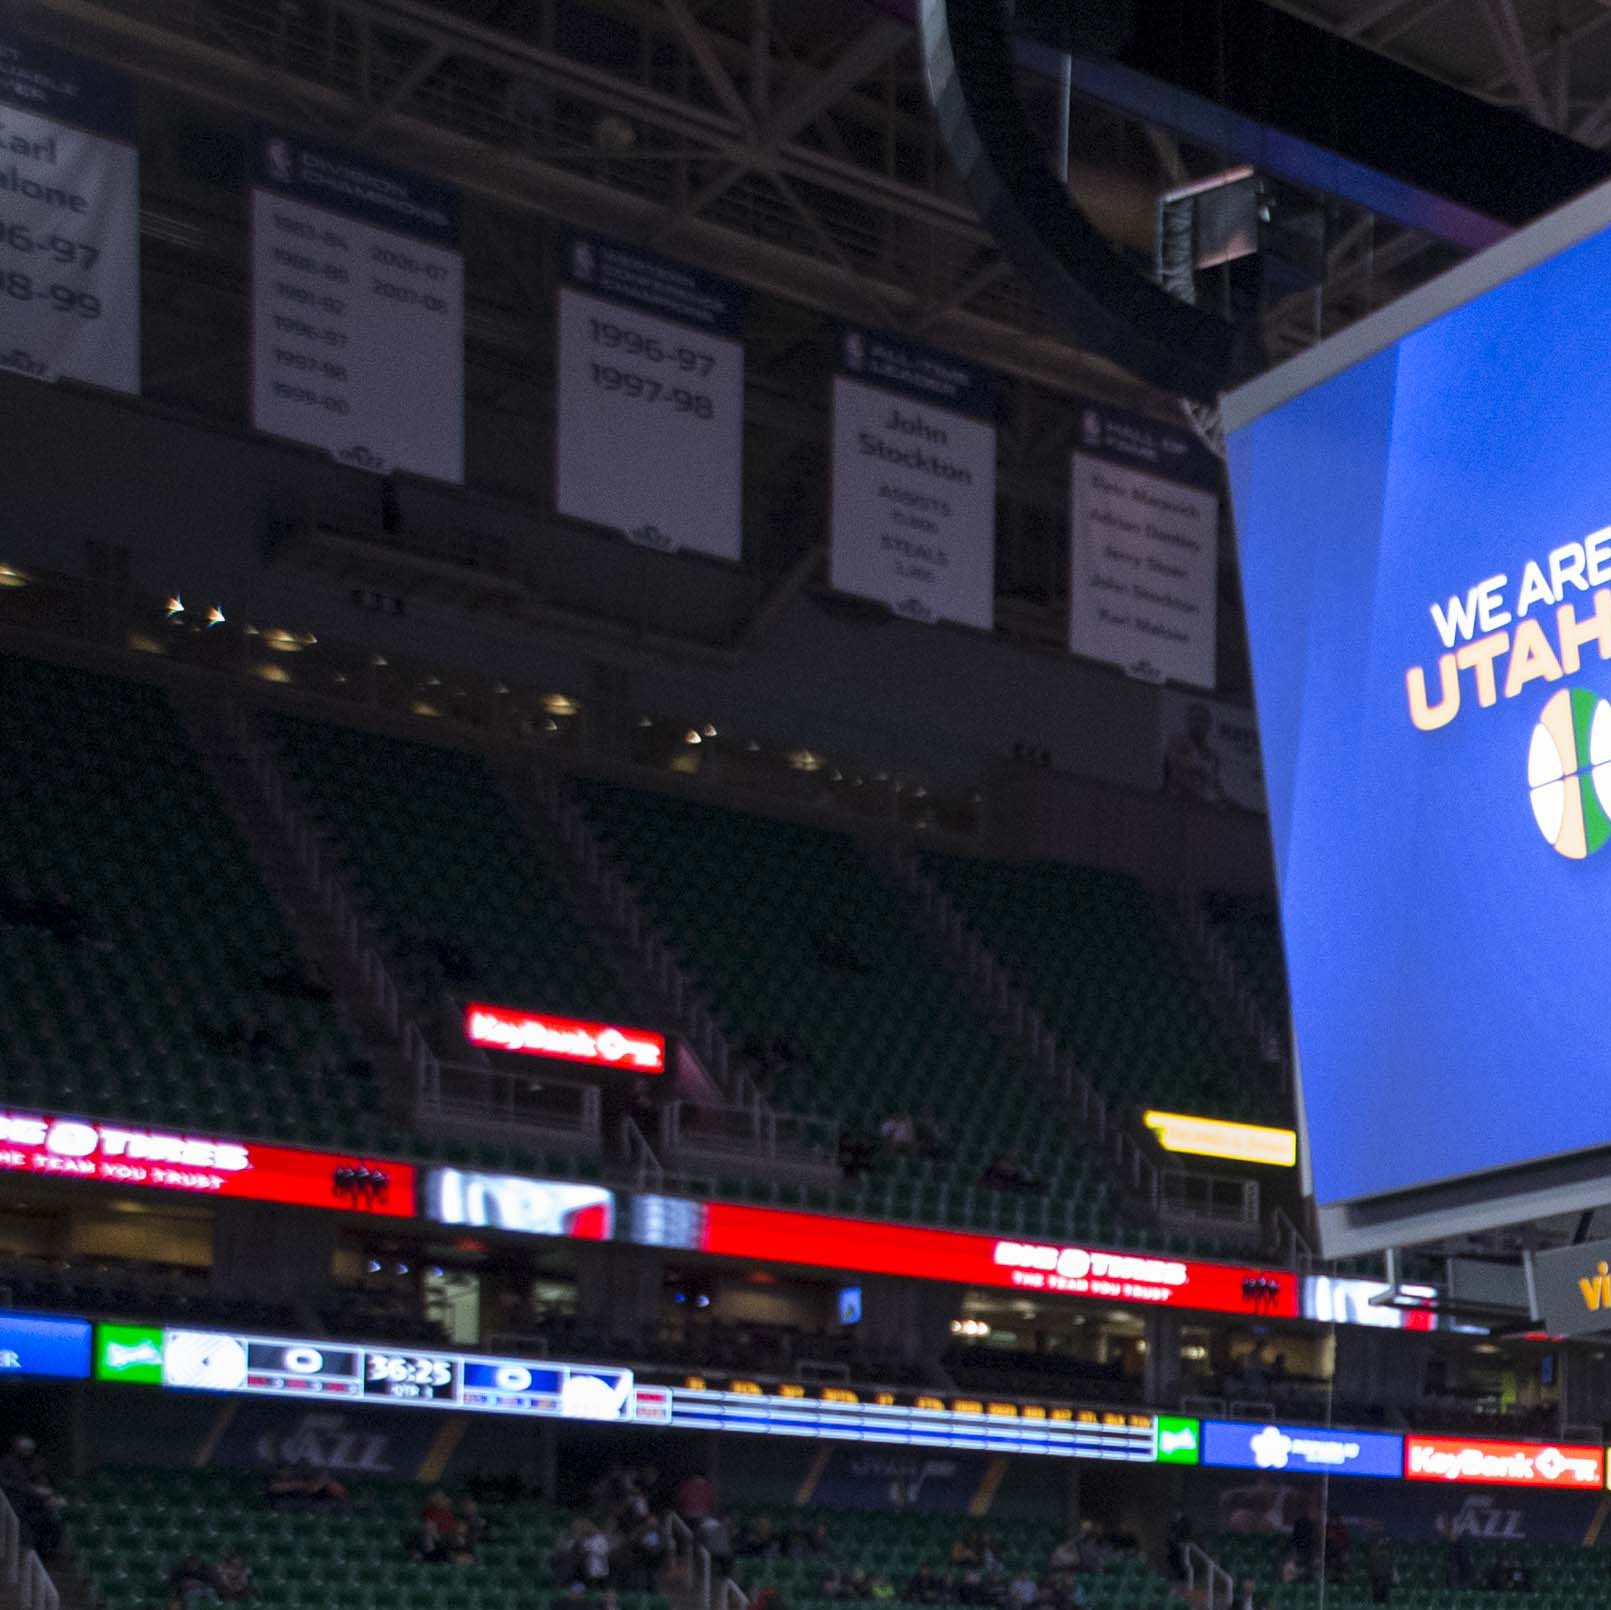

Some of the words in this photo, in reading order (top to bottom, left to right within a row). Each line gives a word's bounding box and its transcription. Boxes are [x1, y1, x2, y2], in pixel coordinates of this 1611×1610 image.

[588, 317, 715, 378] 1996-97
[588, 361, 713, 422] 1997-98
[882, 410, 947, 446] John
[858, 433, 972, 487] Stockton
[1429, 573, 1512, 648] WE
[97, 1127, 251, 1172] TIRES
[32, 1153, 97, 1175] TEAM
[99, 1161, 148, 1182] YOU
[151, 1166, 227, 1190] TRUST
[1011, 1269, 1046, 1288] THE
[1046, 1274, 1089, 1293] TEAM
[1089, 1279, 1121, 1297] YOU
[1121, 1283, 1174, 1302] TRUST
[283, 1347, 324, 1374] 0
[367, 1353, 452, 1386] 36:25
[491, 1365, 533, 1392] 0
[1411, 1445, 1534, 1480] KeyBank
